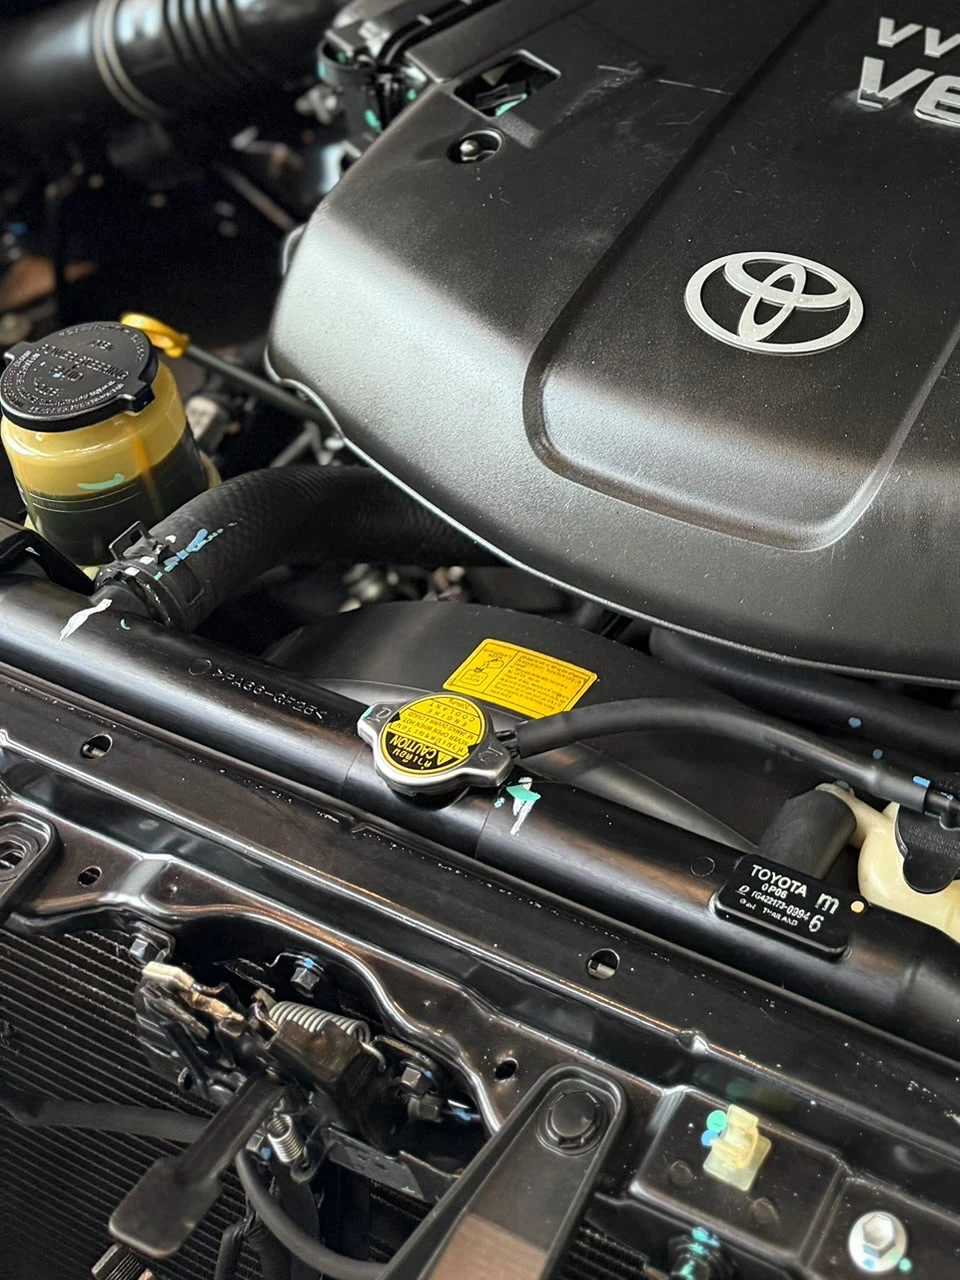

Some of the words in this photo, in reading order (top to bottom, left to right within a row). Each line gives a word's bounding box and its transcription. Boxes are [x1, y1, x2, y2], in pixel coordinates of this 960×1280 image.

[428, 708, 468, 727] ENGINE
[429, 702, 475, 722] COOLANT
[389, 735, 437, 759] CAUTION
[750, 864, 808, 898] TOYOTA
[808, 914, 825, 932] 6
